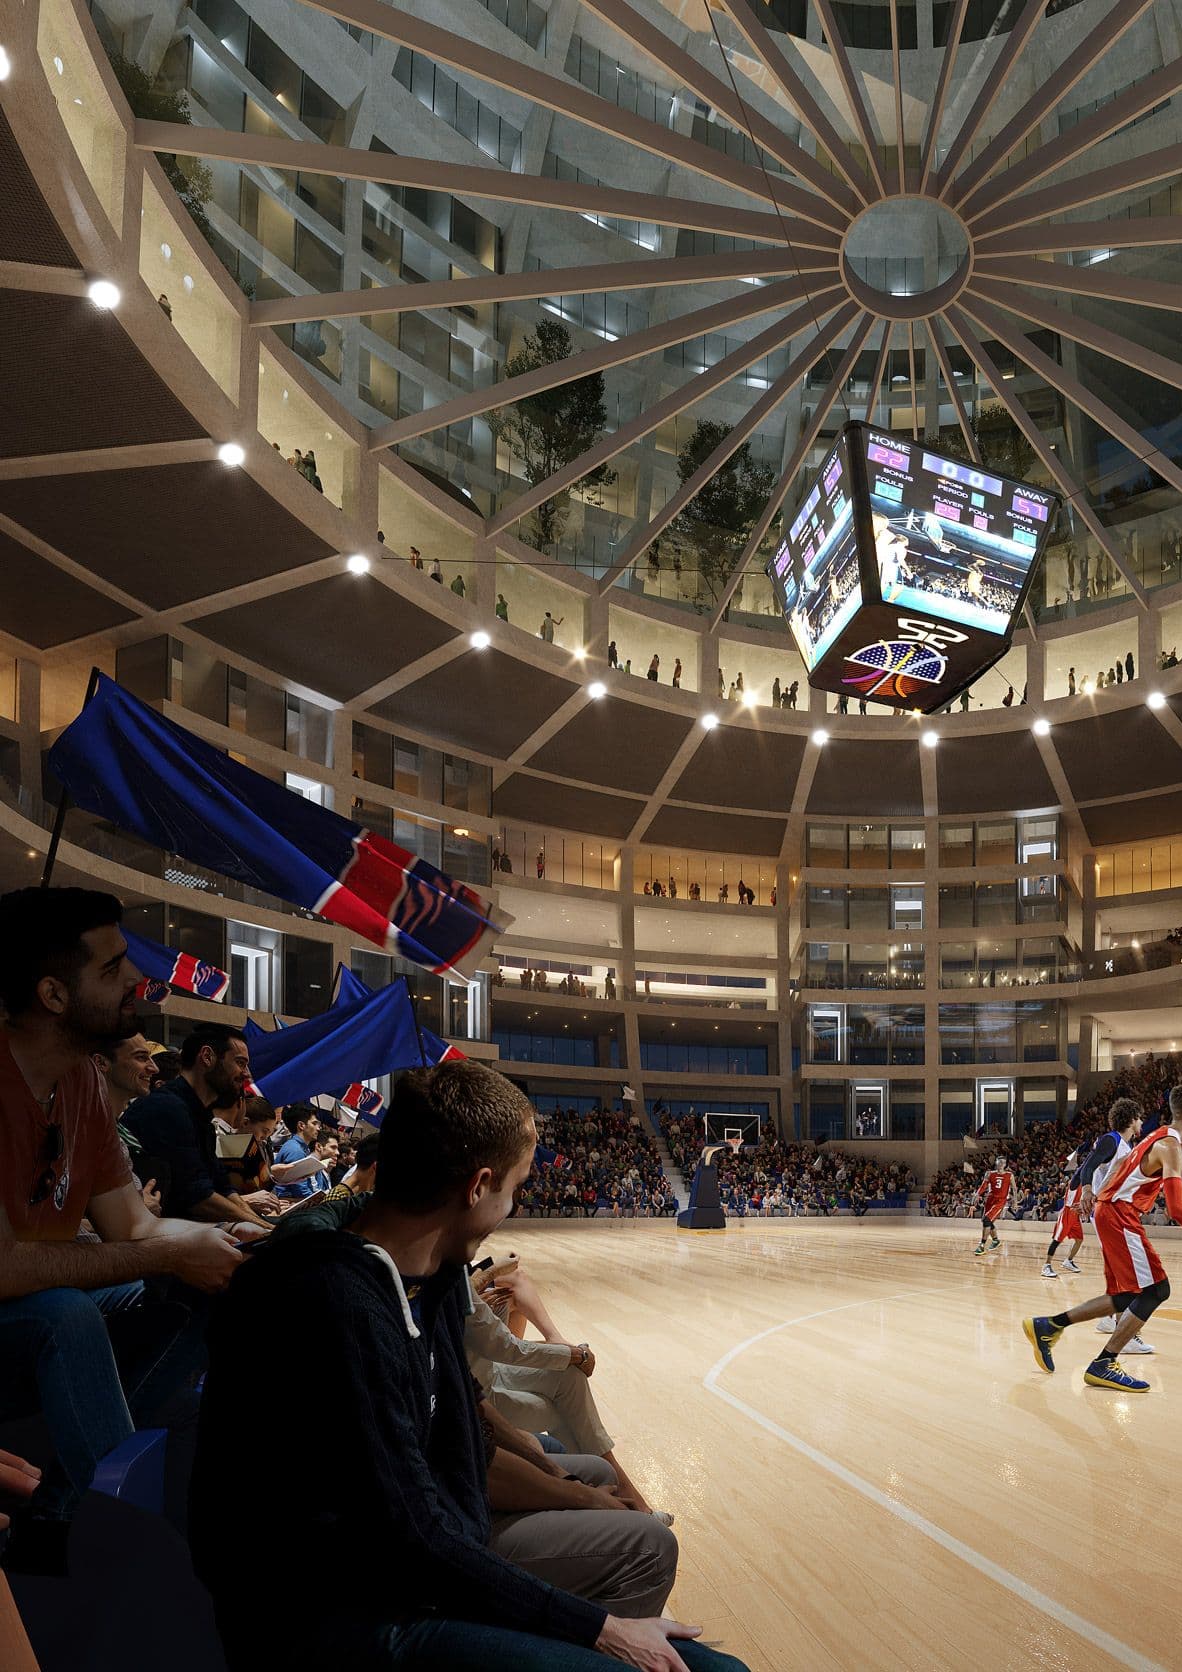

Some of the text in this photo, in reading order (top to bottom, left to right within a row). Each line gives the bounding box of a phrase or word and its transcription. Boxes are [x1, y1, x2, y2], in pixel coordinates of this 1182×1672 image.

[870, 432, 911, 455] HOME
[874, 447, 903, 468] 22
[875, 474, 904, 489] FOULS
[883, 467, 914, 482] BONUS
[937, 484, 969, 499] PERIOD
[1014, 487, 1049, 504] AWAY
[932, 494, 964, 509] PLAYER
[1018, 497, 1043, 520] 57
[968, 507, 995, 520] FOULS
[1006, 511, 1033, 524] BONUS
[1013, 523, 1038, 535] FOULS
[995, 1179, 1003, 1189] 3
